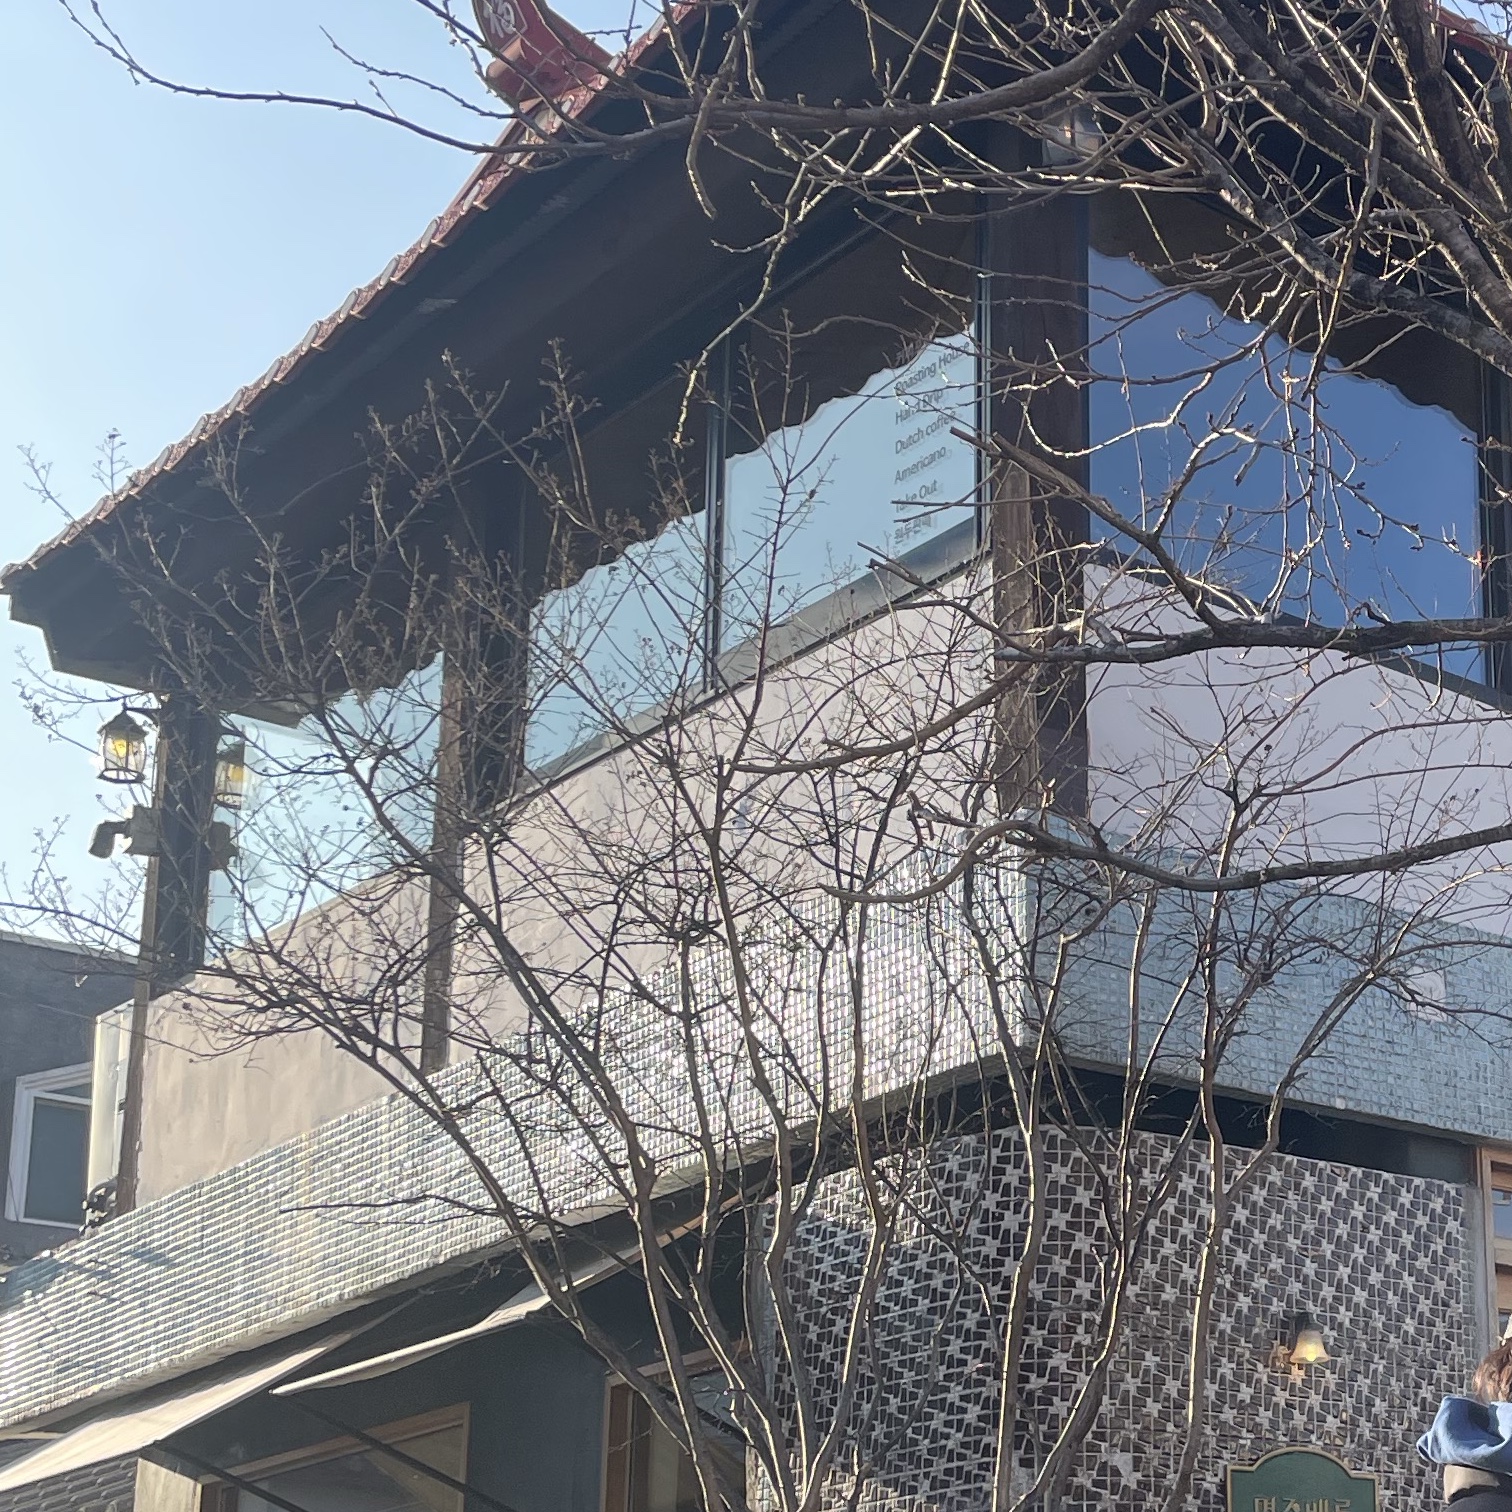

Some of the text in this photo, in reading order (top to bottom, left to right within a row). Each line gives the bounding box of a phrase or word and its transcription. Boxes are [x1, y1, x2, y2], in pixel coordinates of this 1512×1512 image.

[895, 361, 937, 394] Roasting
[922, 389, 944, 408] Drip
[895, 411, 956, 454] Dutch coffee
[894, 447, 947, 484] Americano
[919, 479, 938, 499] Out
